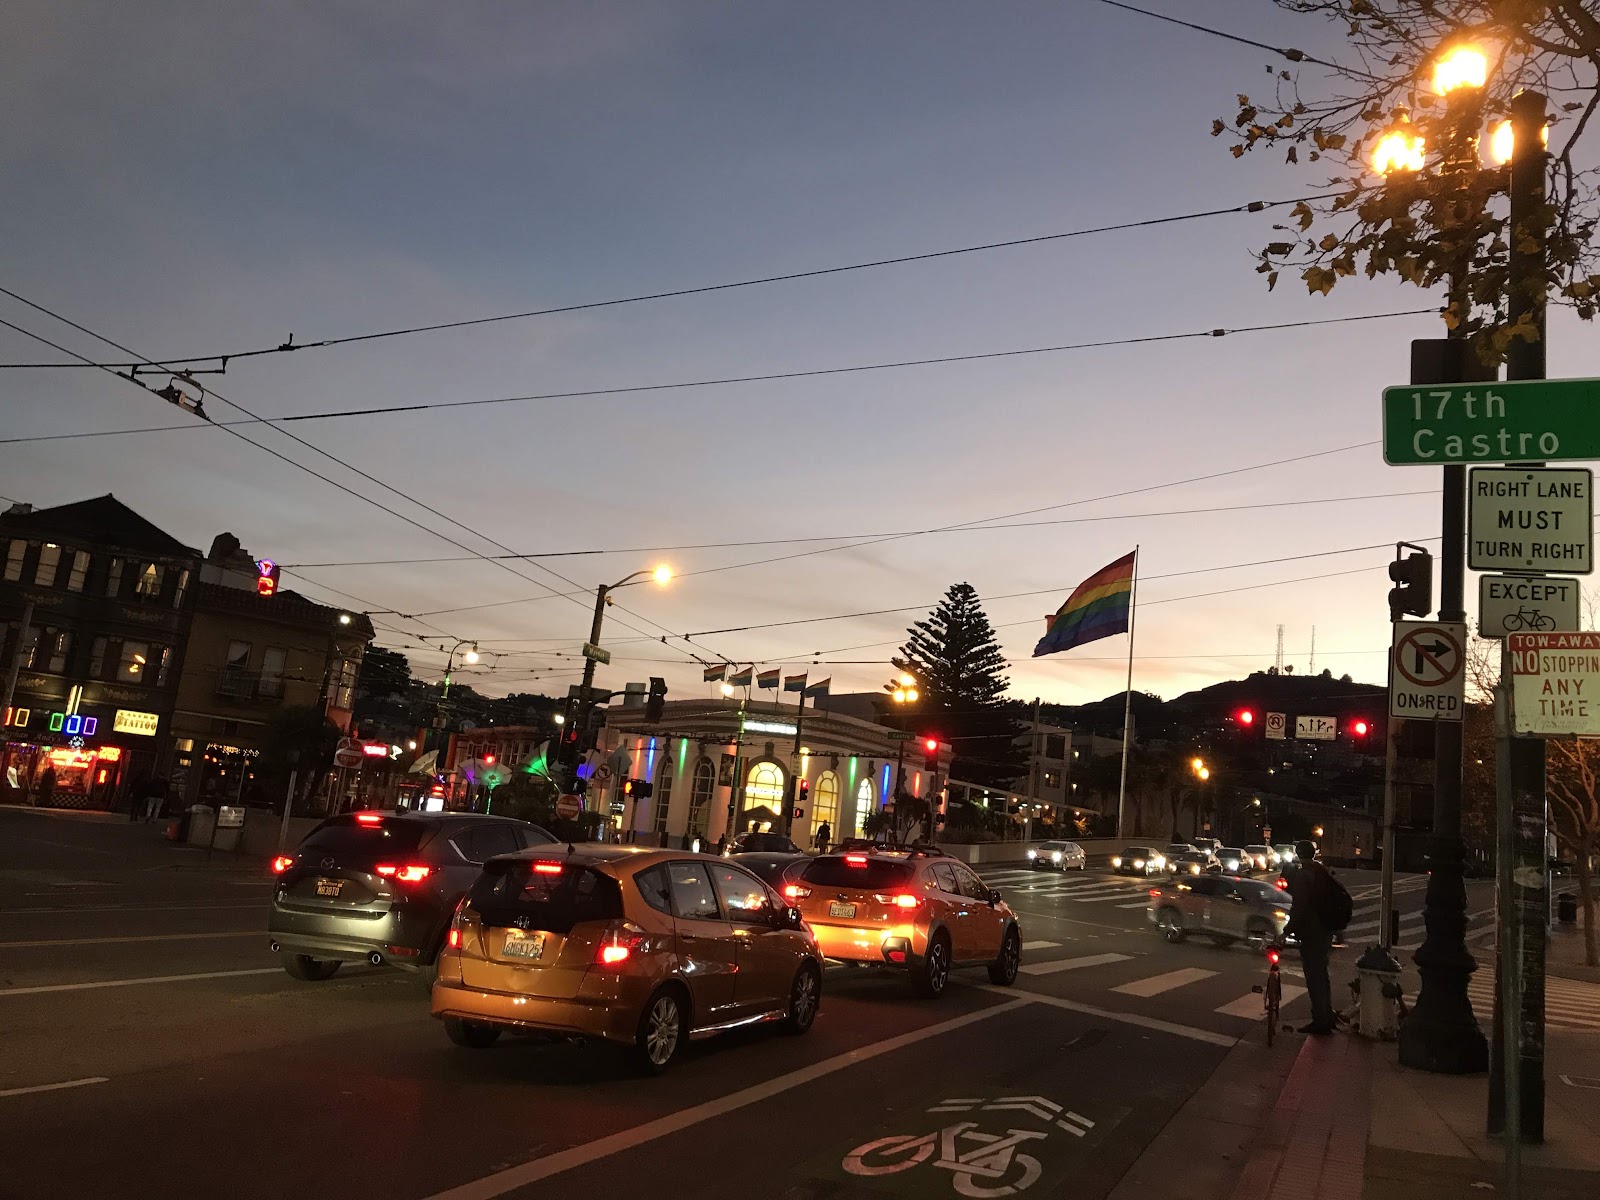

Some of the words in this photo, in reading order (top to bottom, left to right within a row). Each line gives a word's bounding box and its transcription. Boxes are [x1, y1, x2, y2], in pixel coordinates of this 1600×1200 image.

[1412, 390, 1505, 420] 17th
[1413, 428, 1560, 458] Castro
[1477, 481, 1530, 497] RIGHT
[1538, 482, 1584, 498] LANE
[1498, 510, 1563, 530] MUST
[1476, 541, 1522, 557] TURN
[1532, 542, 1585, 560] RIGHT
[1489, 583, 1569, 602] EXCEPT
[1512, 650, 1539, 673] NO
[1542, 678, 1584, 696] ANY
[1397, 692, 1418, 709] ON
[1425, 694, 1457, 711] RED
[1538, 699, 1589, 717] TIME
